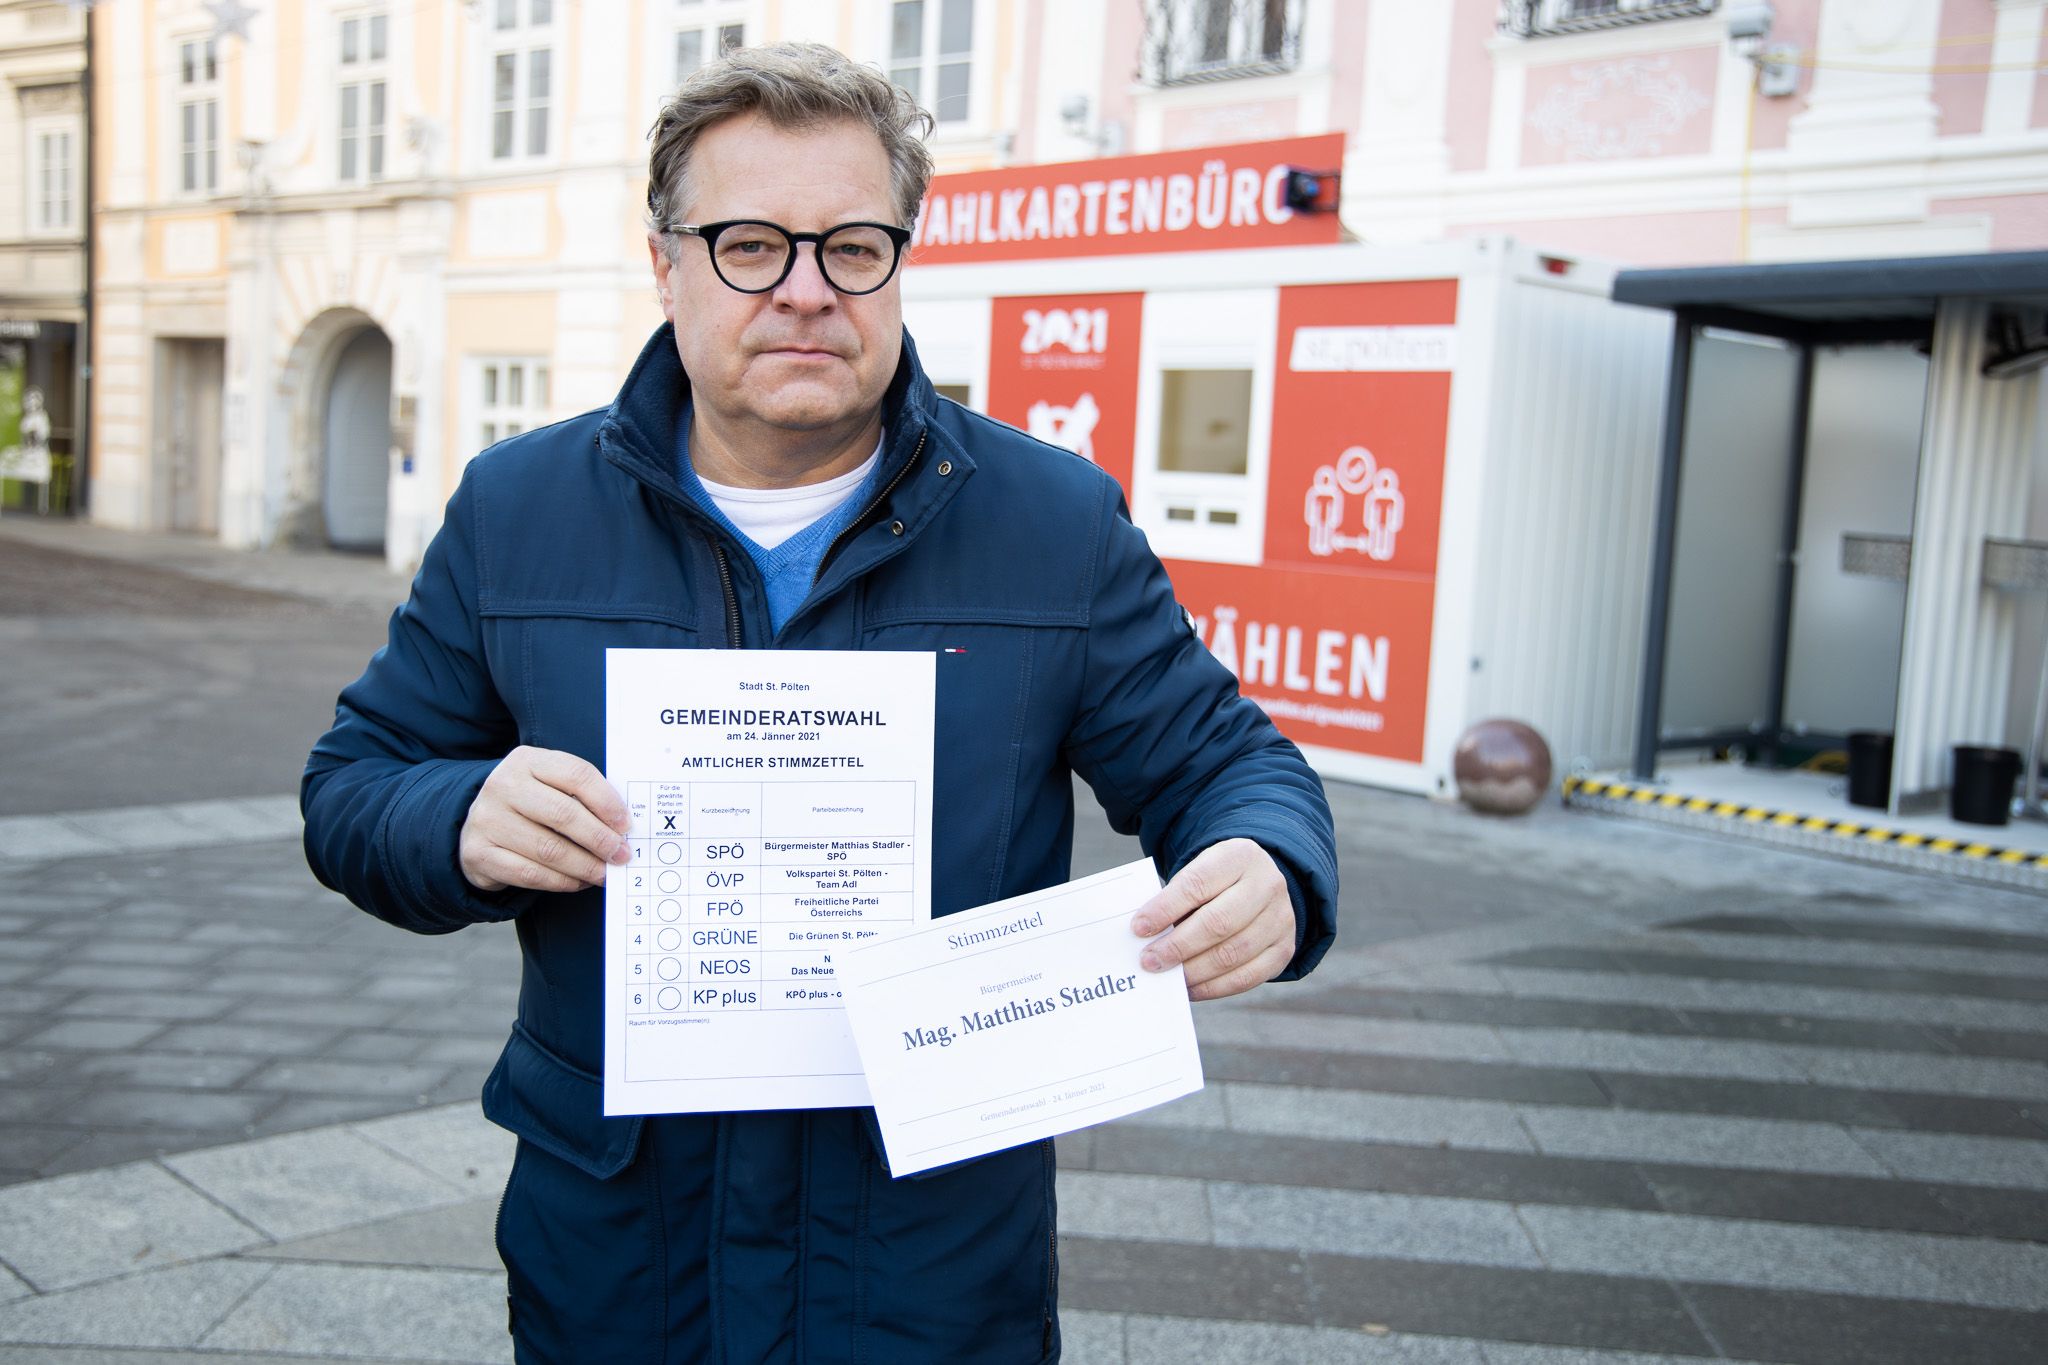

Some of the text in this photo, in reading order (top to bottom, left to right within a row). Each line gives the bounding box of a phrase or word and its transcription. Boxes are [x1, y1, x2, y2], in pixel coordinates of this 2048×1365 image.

[912, 159, 1293, 247] AHLKARTENBÜRO
[1021, 308, 1108, 353] 2021
[740, 682, 763, 690] Stadt
[781, 683, 809, 691] Pölten
[661, 709, 886, 725] GEMEINDERATSWAHL
[745, 732, 758, 740] 24.
[762, 732, 795, 740] Jänner
[799, 732, 819, 740] 2021
[682, 757, 863, 767] AMTLICHER STIMMZETTEL
[701, 807, 751, 816] Kurzbezeichnung
[664, 816, 676, 830] X
[707, 843, 744, 859] SPÖ
[765, 843, 829, 851] Bürgermeister
[636, 848, 640, 857] 1
[827, 851, 847, 860] SPÖ
[707, 872, 744, 887] ÖVP
[786, 870, 835, 879] Volkspartei
[635, 877, 641, 886] 2
[635, 906, 642, 915] 3
[708, 900, 743, 916] FPÖ
[948, 911, 1044, 949] Stimmzettel
[635, 935, 641, 944] 4
[693, 929, 757, 945] GRÜNE
[789, 932, 803, 941] Die
[806, 931, 839, 941] Grünen
[842, 931, 854, 940] St.
[635, 964, 641, 974] 5
[701, 960, 750, 974] NEOS
[979, 974, 1043, 995] Bürgermeister
[635, 994, 641, 1004] 6
[694, 990, 756, 1007] KP plus
[786, 989, 806, 998] KPÖ
[809, 991, 828, 999] plus
[903, 973, 1136, 1050] Mag. Matthias Stadler
[980, 1097, 1047, 1122] Gemeinderatswahl
